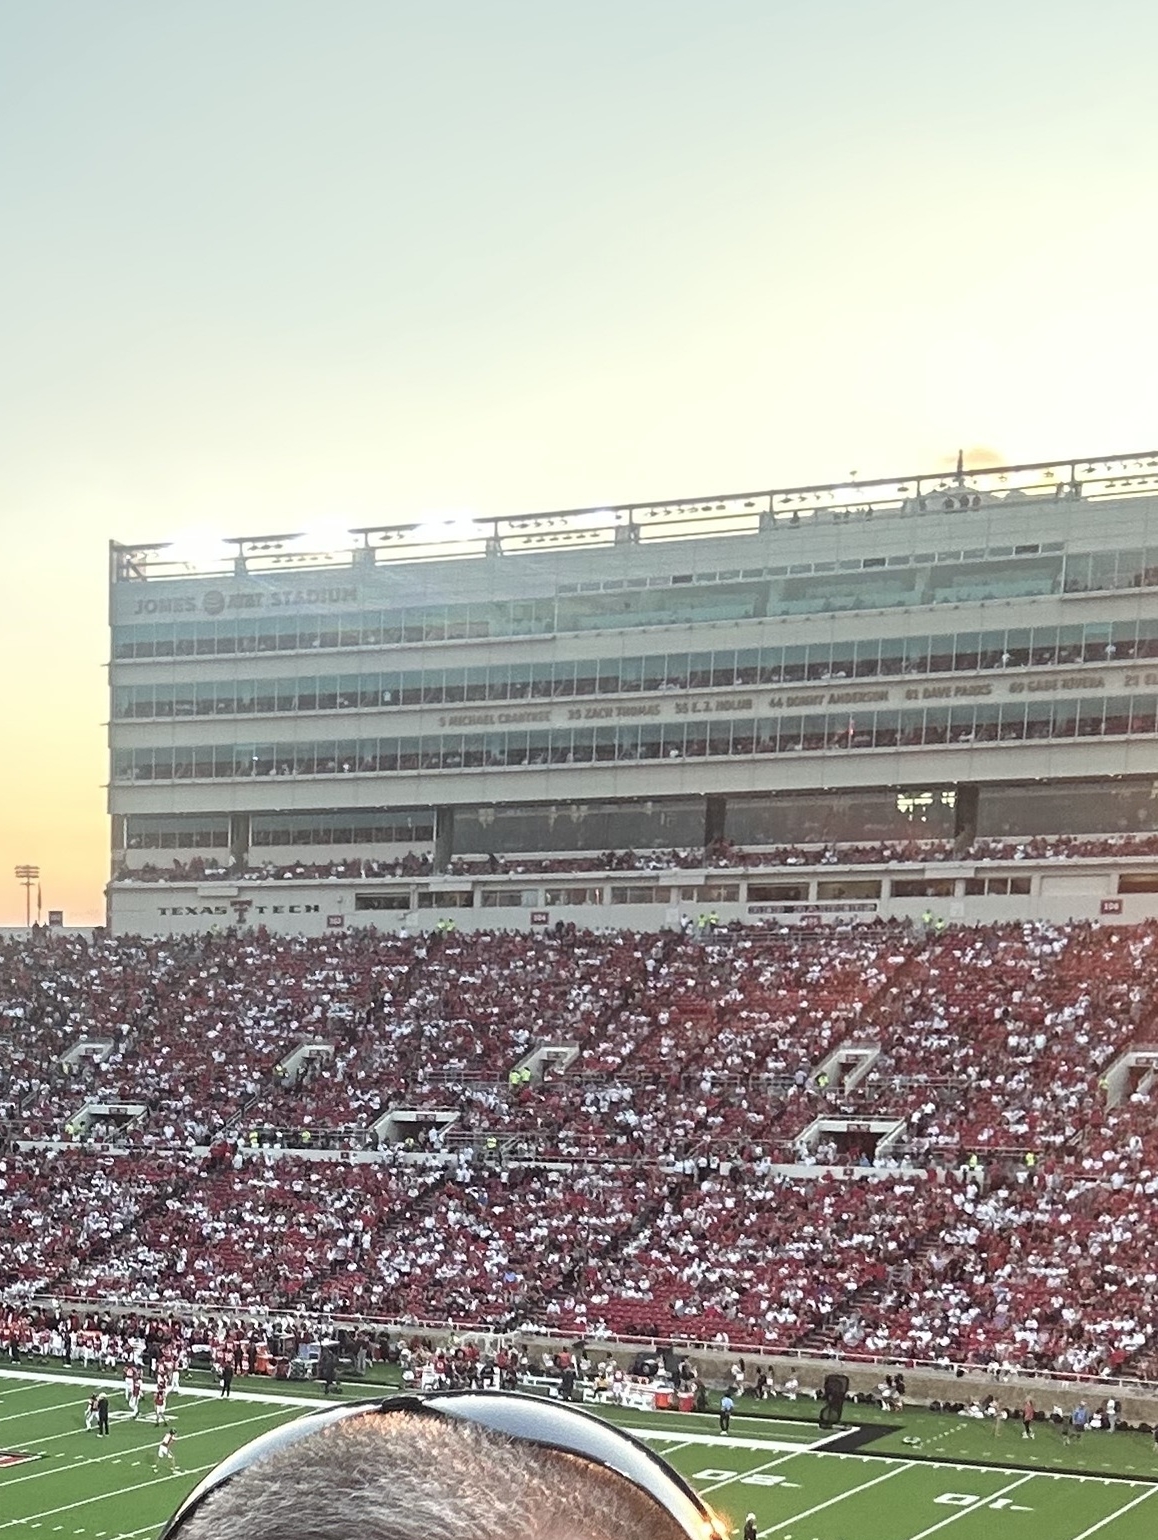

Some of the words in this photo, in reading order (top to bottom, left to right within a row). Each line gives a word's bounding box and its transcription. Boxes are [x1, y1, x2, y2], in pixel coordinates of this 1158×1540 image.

[134, 596, 196, 615] JONES
[270, 586, 359, 607] STADIUM
[827, 690, 889, 705] ANDERSON
[922, 686, 952, 699] DAVE
[448, 712, 496, 727] MICHAEL
[157, 905, 228, 917] TEXAS
[255, 903, 320, 915] TECH
